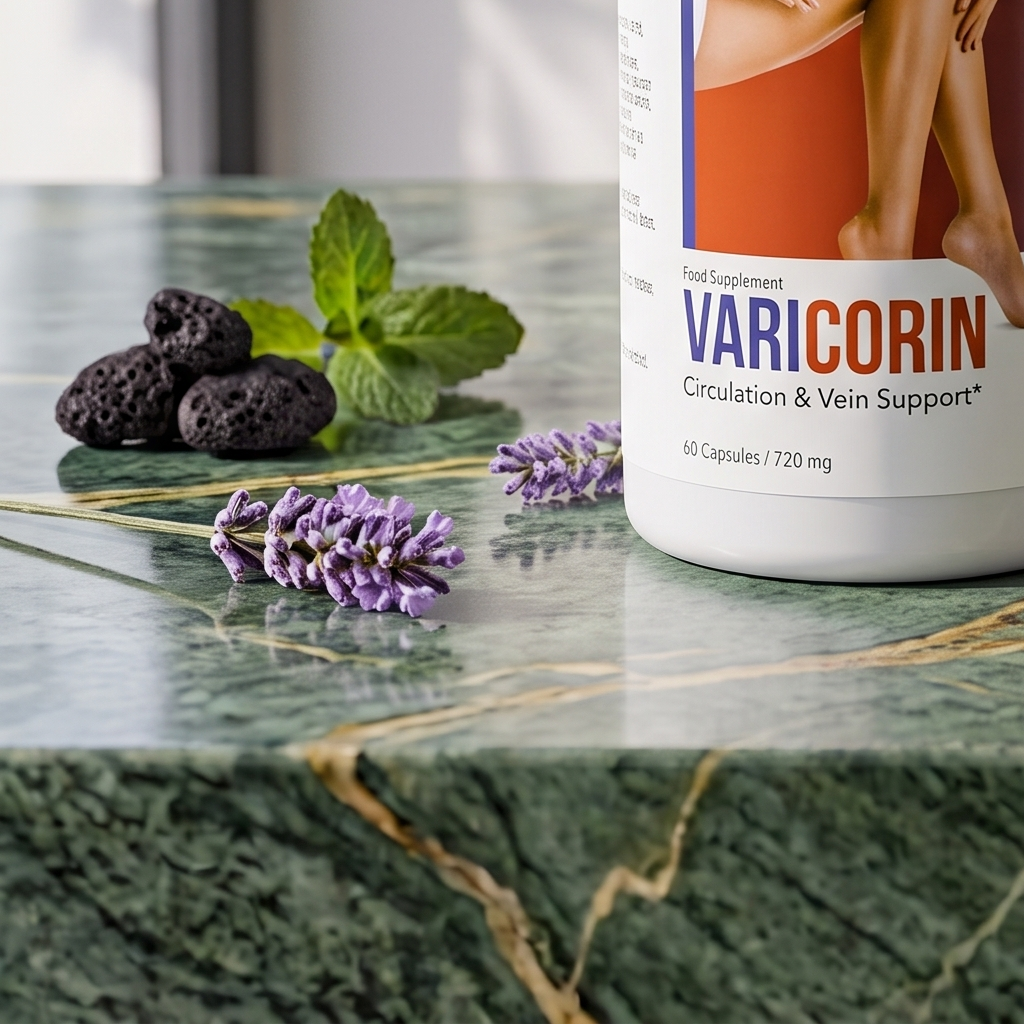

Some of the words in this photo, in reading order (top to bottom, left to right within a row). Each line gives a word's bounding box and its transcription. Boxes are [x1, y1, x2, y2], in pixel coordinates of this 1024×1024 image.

[683, 266, 707, 284] Food
[710, 269, 783, 291] Supplement
[683, 288, 987, 374] VARICORIN
[683, 376, 786, 407] Circulation
[795, 386, 812, 408] &
[818, 387, 869, 409] Vein
[683, 440, 698, 457] 60
[701, 443, 760, 466] Capsules
[763, 450, 770, 466] /
[773, 451, 803, 468] 720
[807, 455, 832, 474] mg
